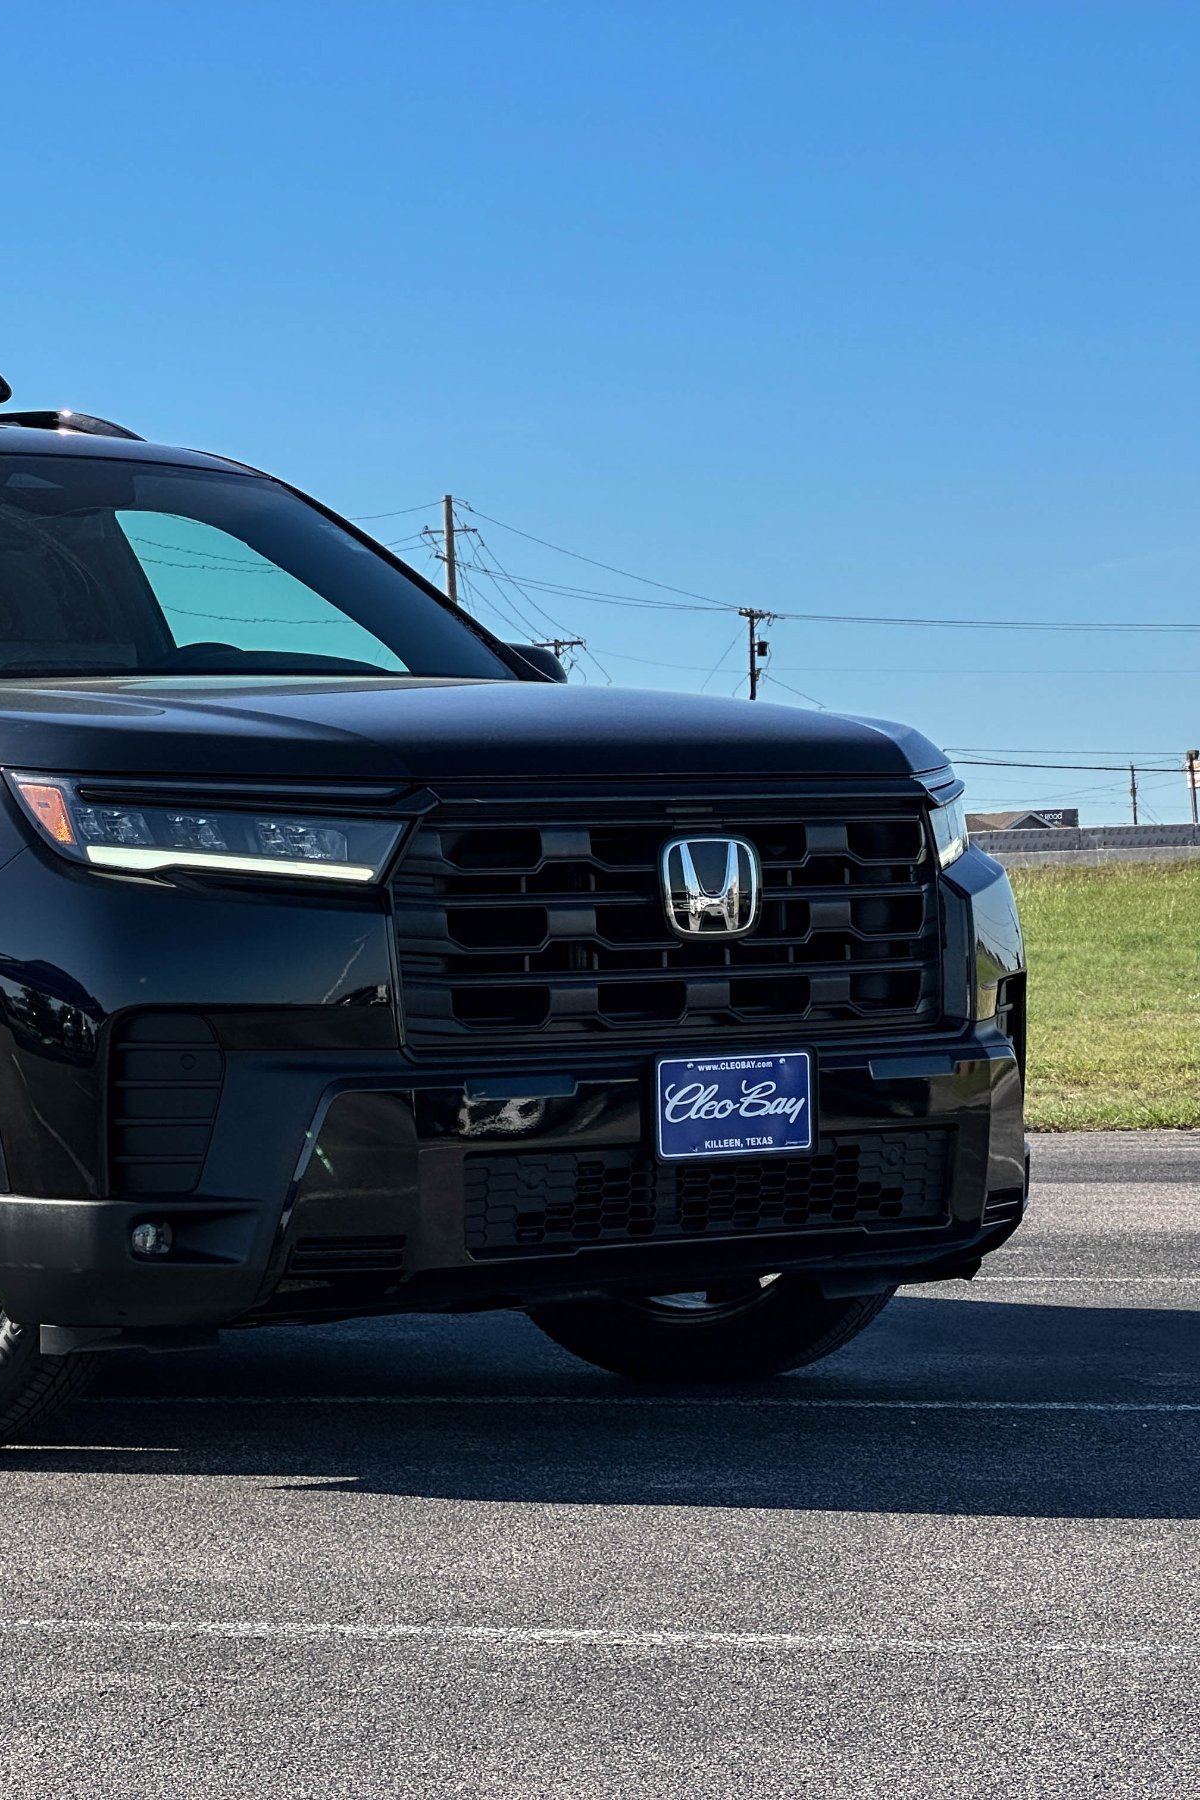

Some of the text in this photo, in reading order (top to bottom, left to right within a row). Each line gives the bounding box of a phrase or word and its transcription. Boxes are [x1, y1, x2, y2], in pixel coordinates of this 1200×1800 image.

[697, 1060, 773, 1072] www.CLEOBAY.com
[665, 1080, 805, 1124] Cleo Bay
[705, 1138, 744, 1149] KILLEEN,
[745, 1136, 773, 1147] TEXAS
